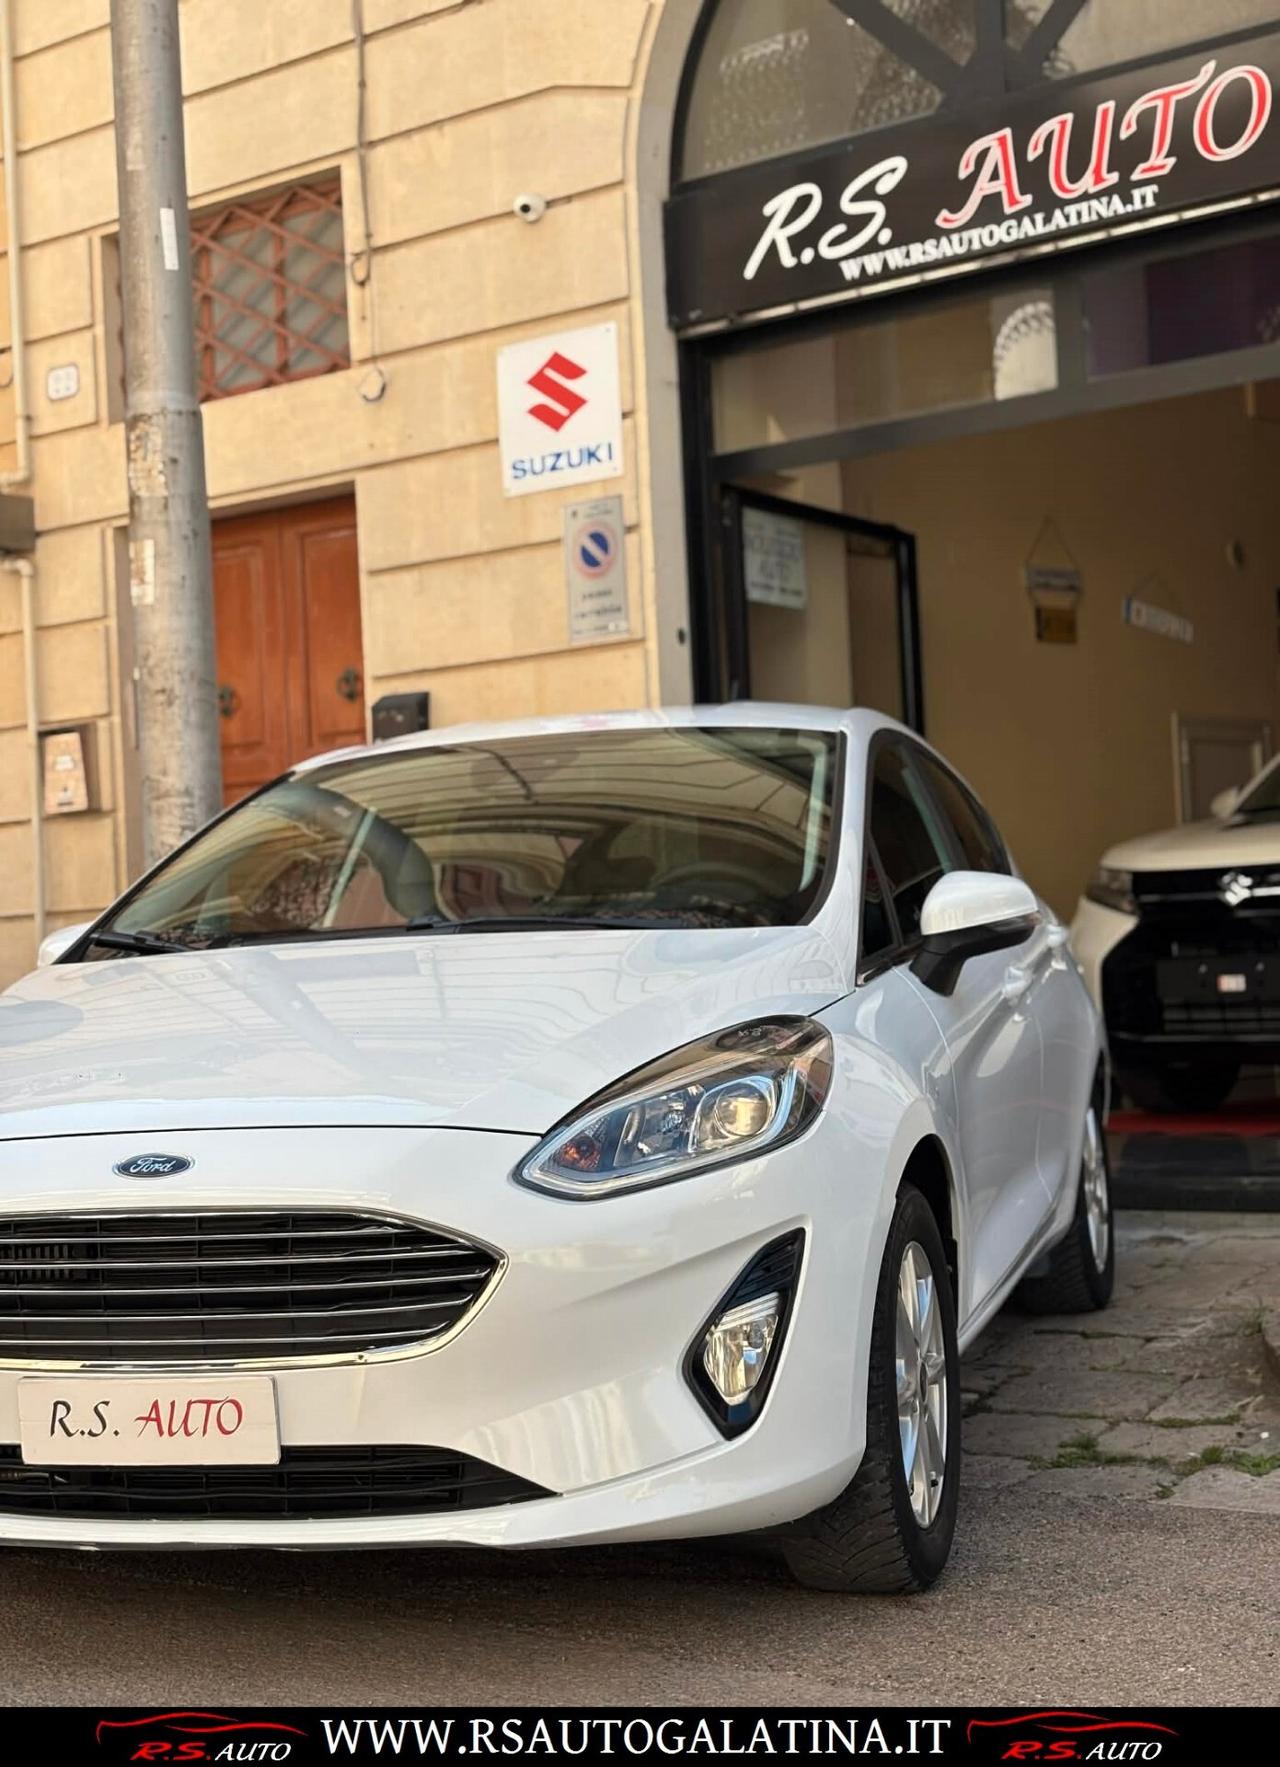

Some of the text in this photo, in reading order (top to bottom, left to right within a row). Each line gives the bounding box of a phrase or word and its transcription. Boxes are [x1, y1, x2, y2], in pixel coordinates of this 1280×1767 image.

[743, 59, 1273, 281] R.S. AUTO
[838, 185, 1159, 281] WWW.RSAUTOGALATINA.IT
[511, 442, 614, 481] SUZUKI
[129, 1156, 174, 1174] Ford
[50, 1394, 244, 1438] R.S. AUTO
